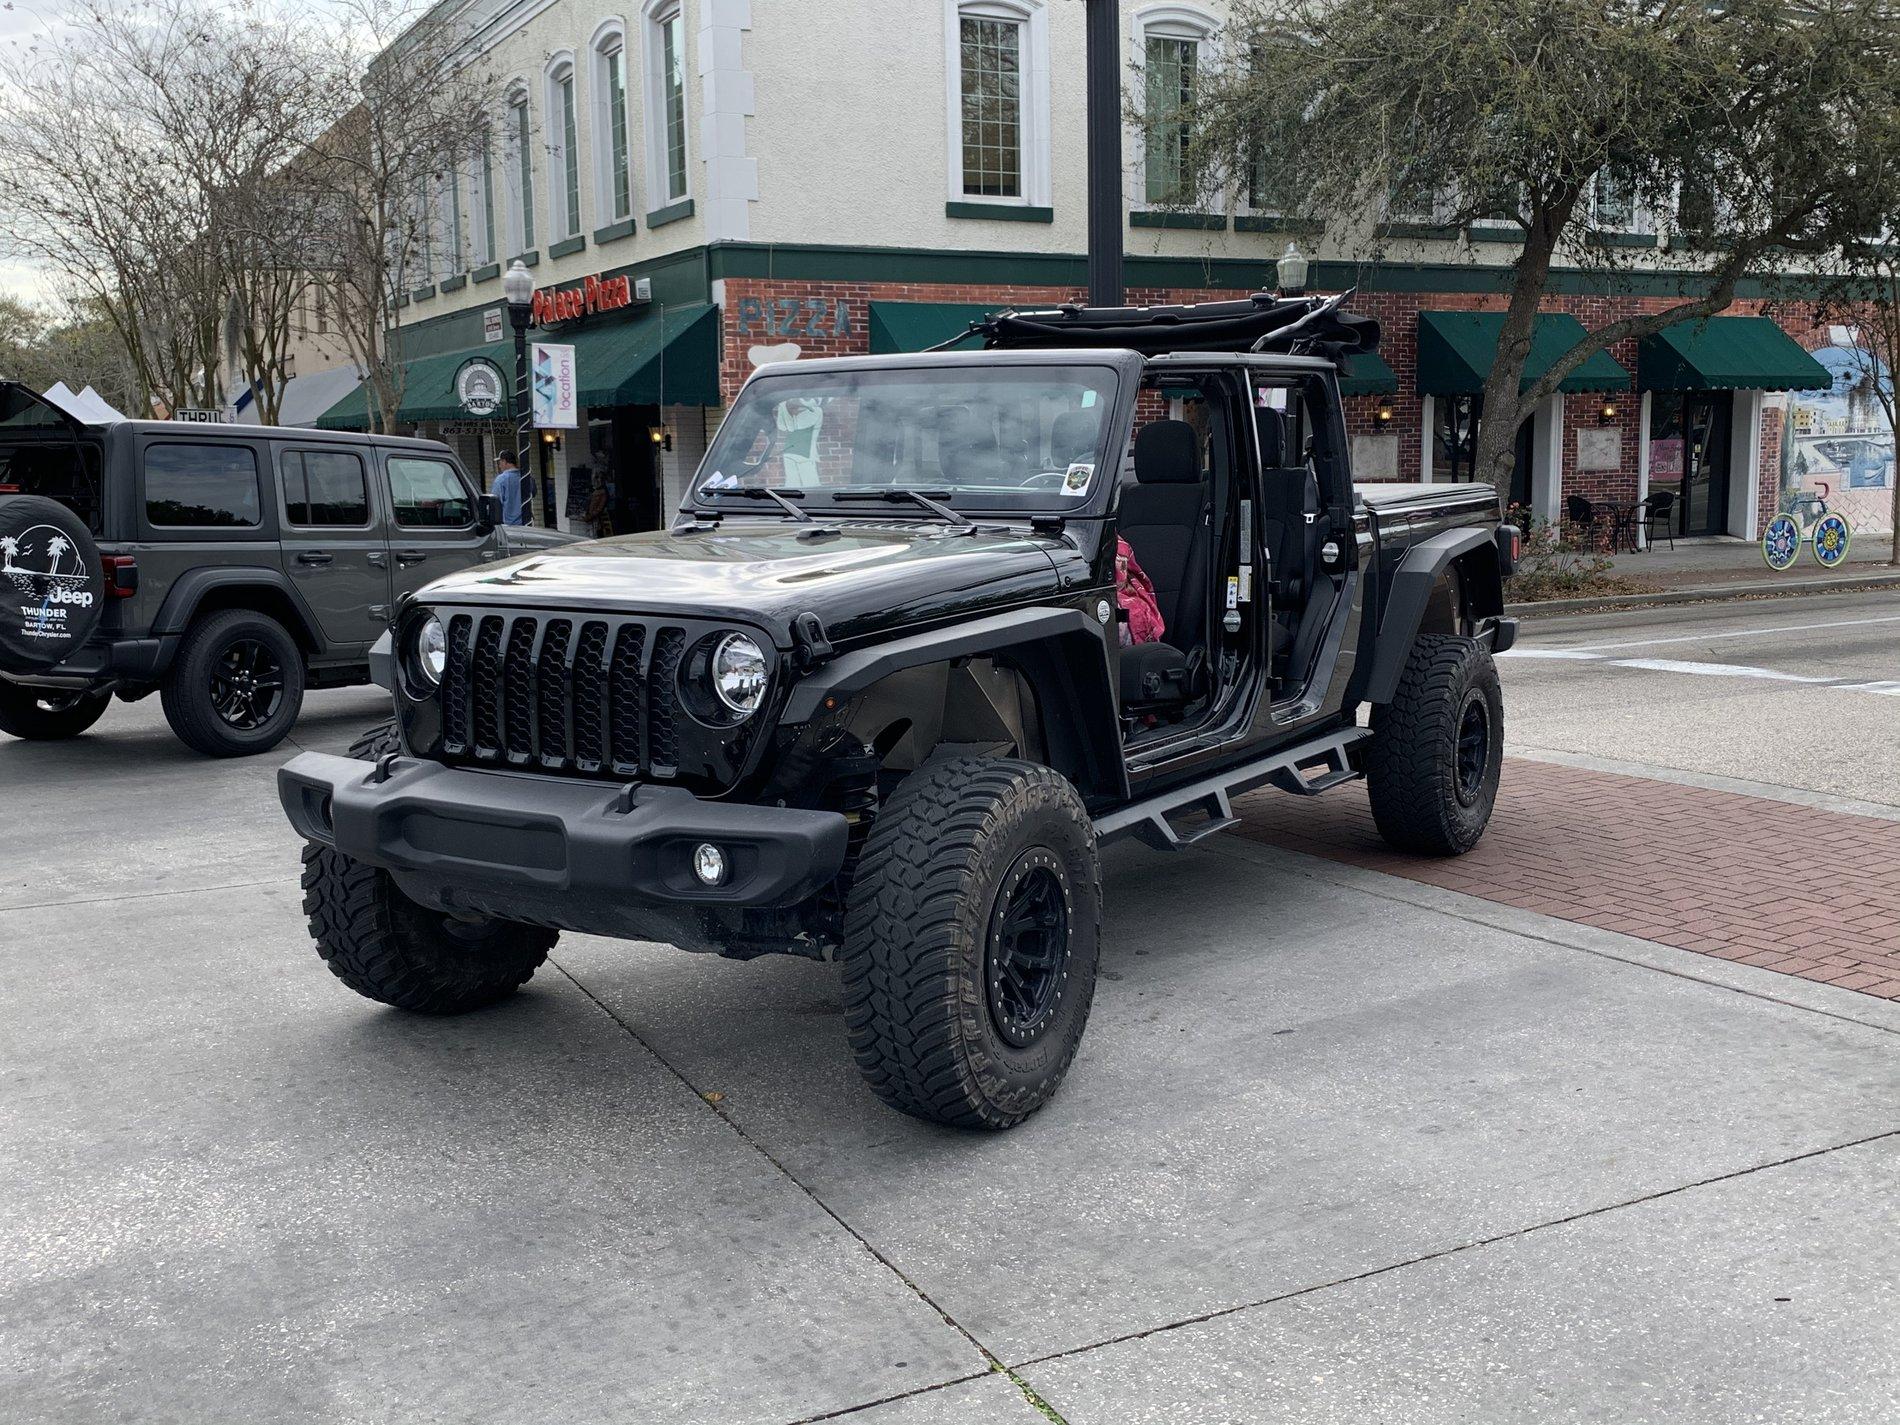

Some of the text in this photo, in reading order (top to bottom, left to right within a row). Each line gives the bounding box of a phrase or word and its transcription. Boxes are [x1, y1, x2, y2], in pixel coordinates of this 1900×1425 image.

[533, 286, 584, 325] Palace
[584, 273, 632, 315] Pizza
[738, 298, 853, 338] PIZZA
[559, 360, 571, 411] location
[50, 586, 93, 608] Jeep
[21, 606, 67, 619] THUNDER
[21, 628, 71, 639] ThunderChrysler.com
[25, 621, 54, 630] BARTOW,
